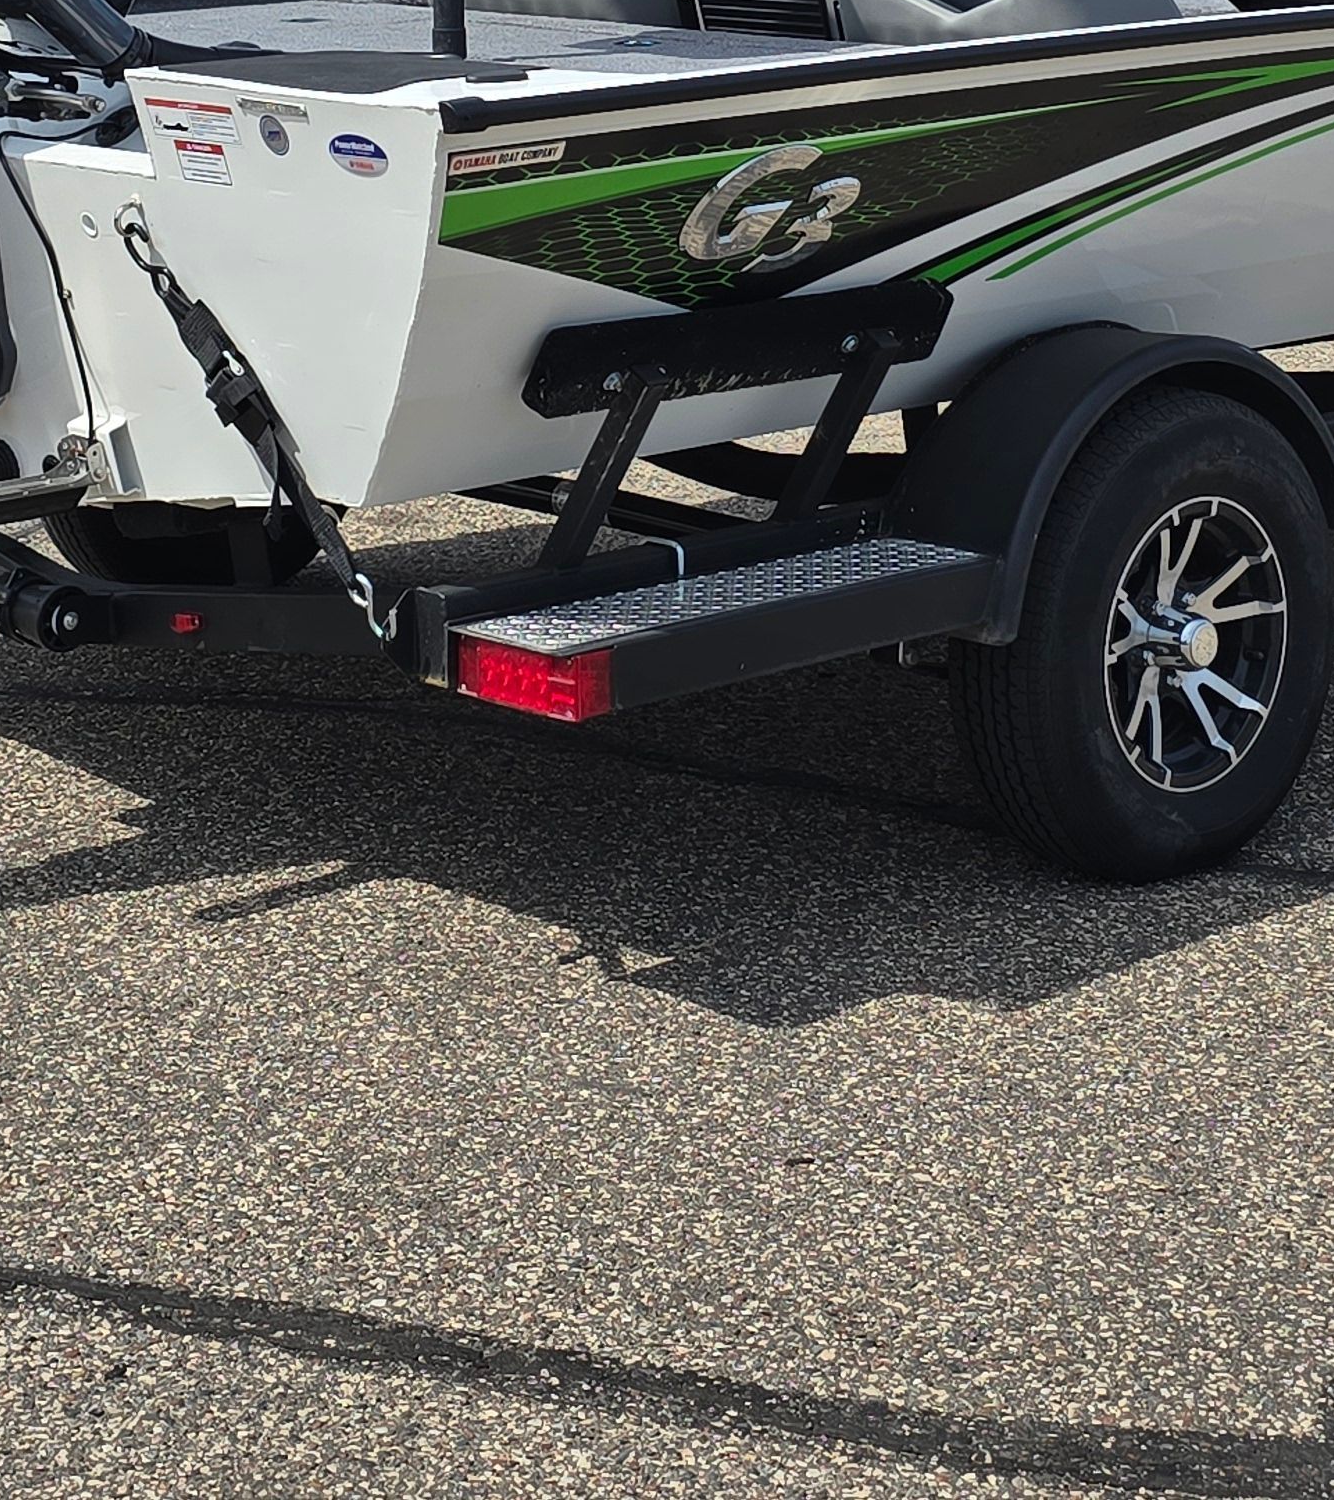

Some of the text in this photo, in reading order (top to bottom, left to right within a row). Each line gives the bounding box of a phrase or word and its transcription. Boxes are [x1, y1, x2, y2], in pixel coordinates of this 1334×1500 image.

[463, 145, 560, 169] YAMAHA BOAT COMPANY
[678, 143, 862, 273] G3
